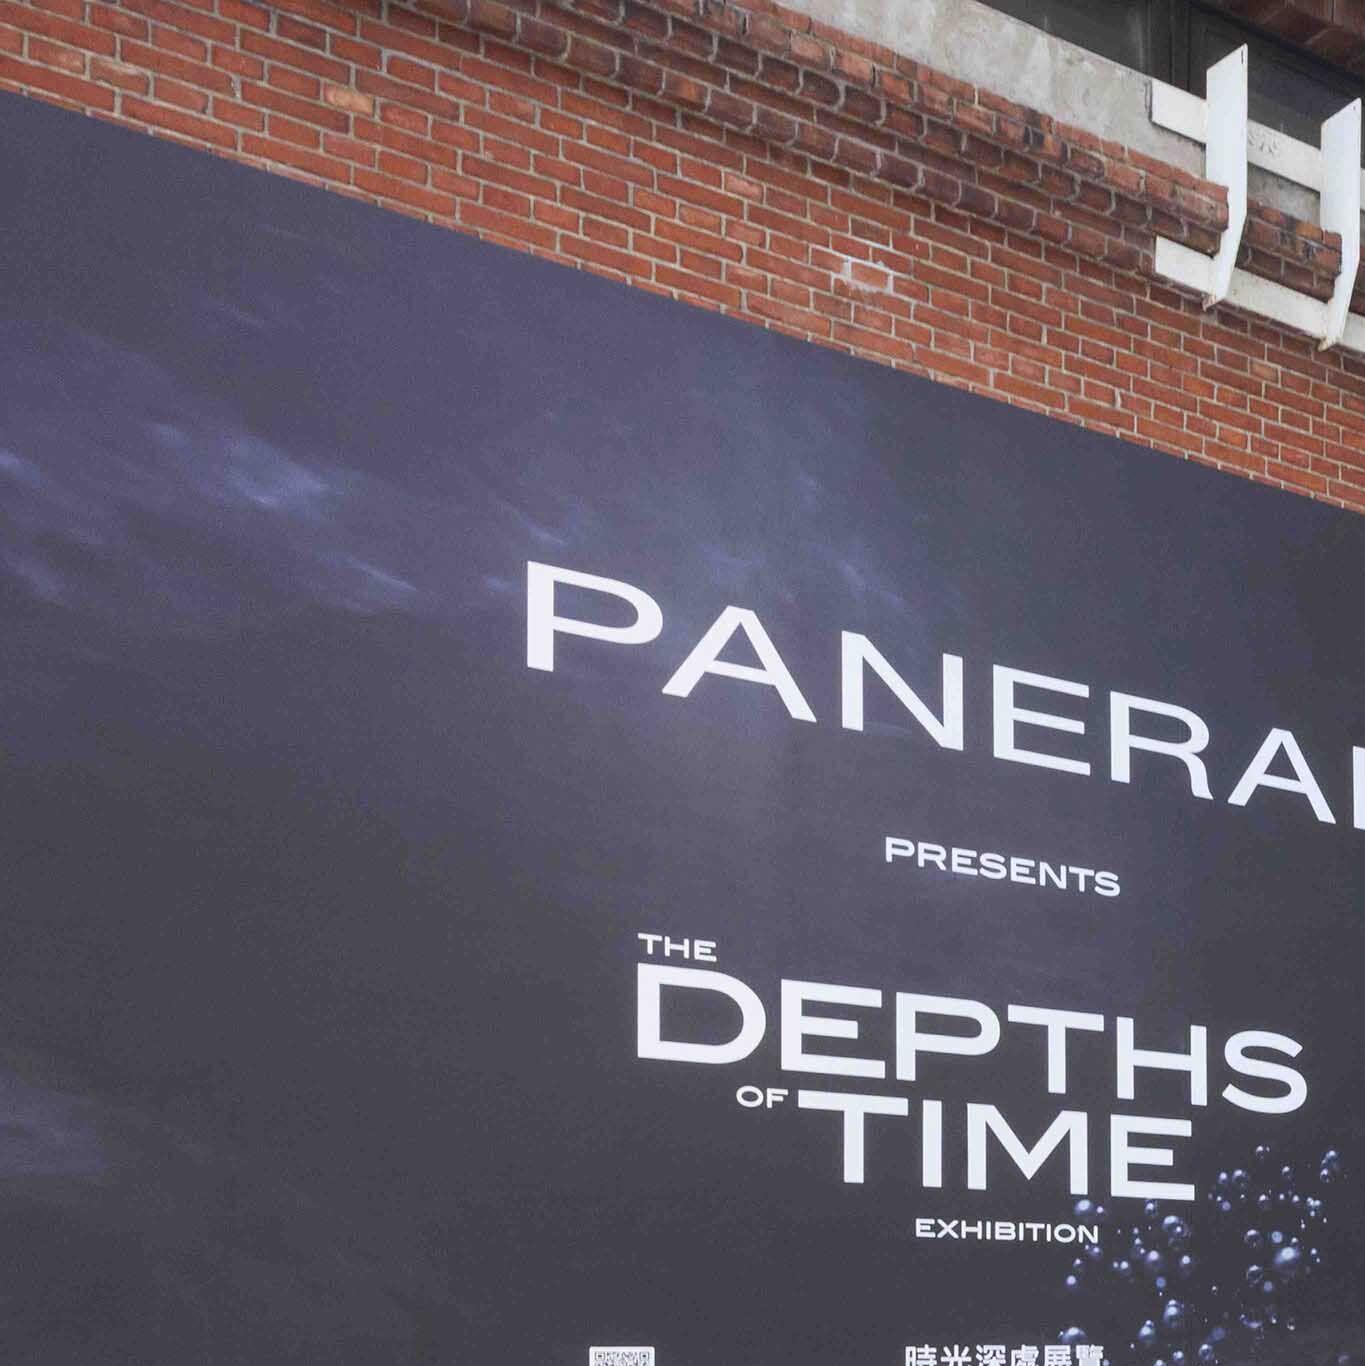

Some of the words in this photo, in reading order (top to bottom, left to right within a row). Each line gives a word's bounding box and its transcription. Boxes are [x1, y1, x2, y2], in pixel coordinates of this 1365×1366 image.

[885, 836, 1121, 897] PRESENTS
[637, 932, 718, 963] THE
[636, 963, 1308, 1114] DEPTHS
[735, 1085, 789, 1110] OF
[797, 1089, 1196, 1201] TIME
[915, 1217, 1100, 1244] EXHIBITION
